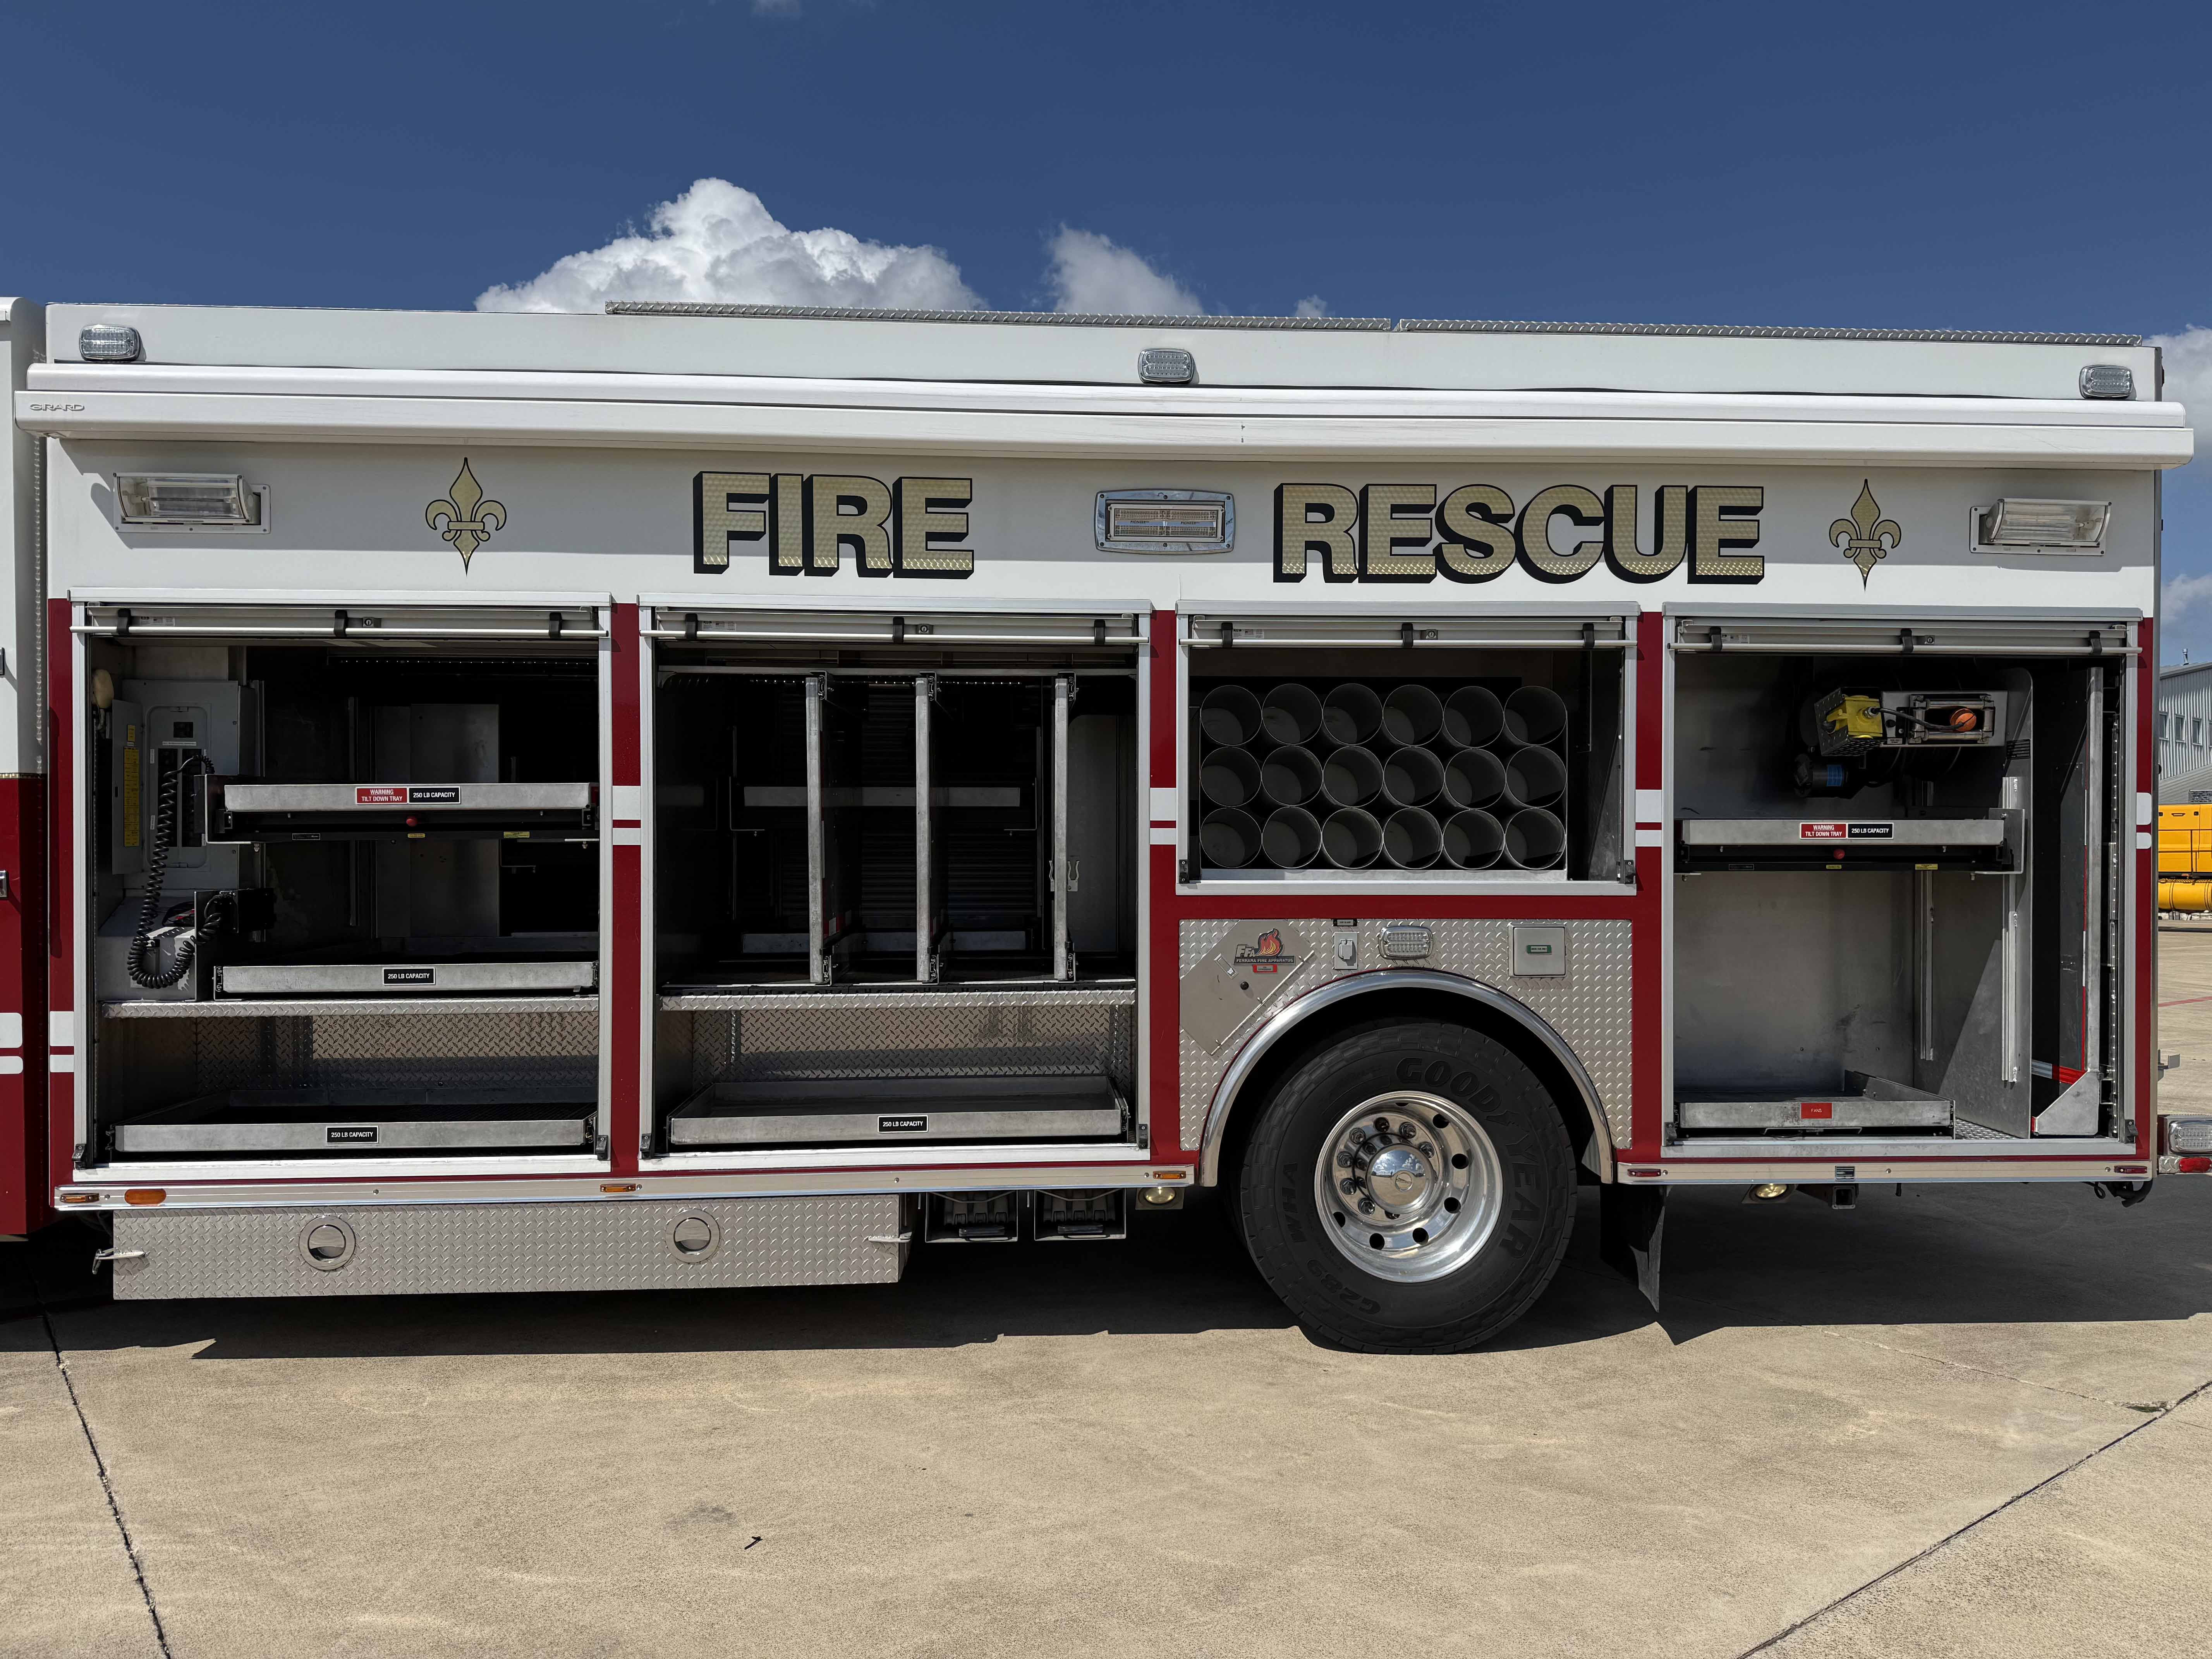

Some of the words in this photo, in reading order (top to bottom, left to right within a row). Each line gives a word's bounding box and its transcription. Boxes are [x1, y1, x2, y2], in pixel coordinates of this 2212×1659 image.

[693, 471, 974, 579] FIRE
[1274, 483, 1765, 584] RESCUE
[1236, 944, 1255, 957] FFA
[1396, 1057, 1540, 1259] GOODYEAR
